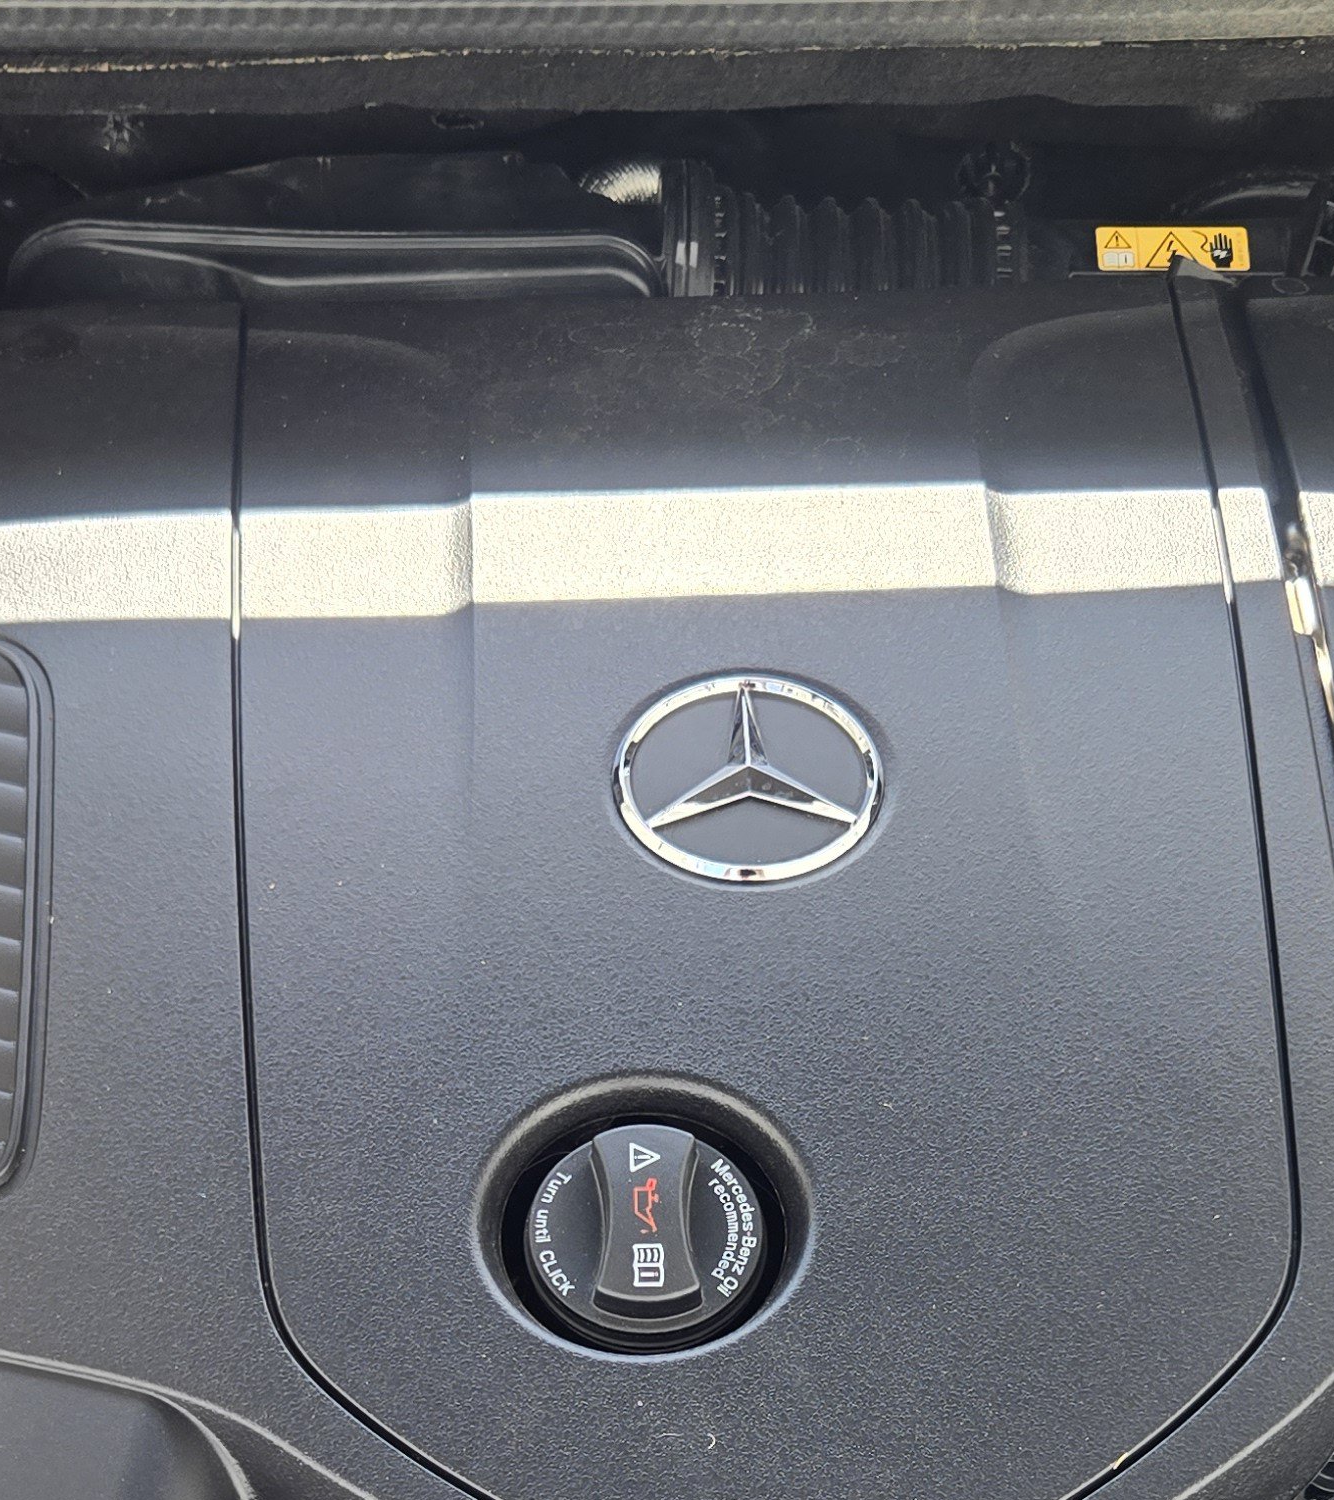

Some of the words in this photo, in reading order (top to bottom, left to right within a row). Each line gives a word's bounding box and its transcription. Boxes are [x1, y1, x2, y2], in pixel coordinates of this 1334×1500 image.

[541, 1170, 573, 1204] Turn
[534, 1208, 550, 1243] until
[707, 1177, 739, 1280] recommended
[709, 1159, 757, 1275] Mercedes-Benz
[539, 1250, 576, 1297] CLICK
[716, 1276, 739, 1298] Oil
